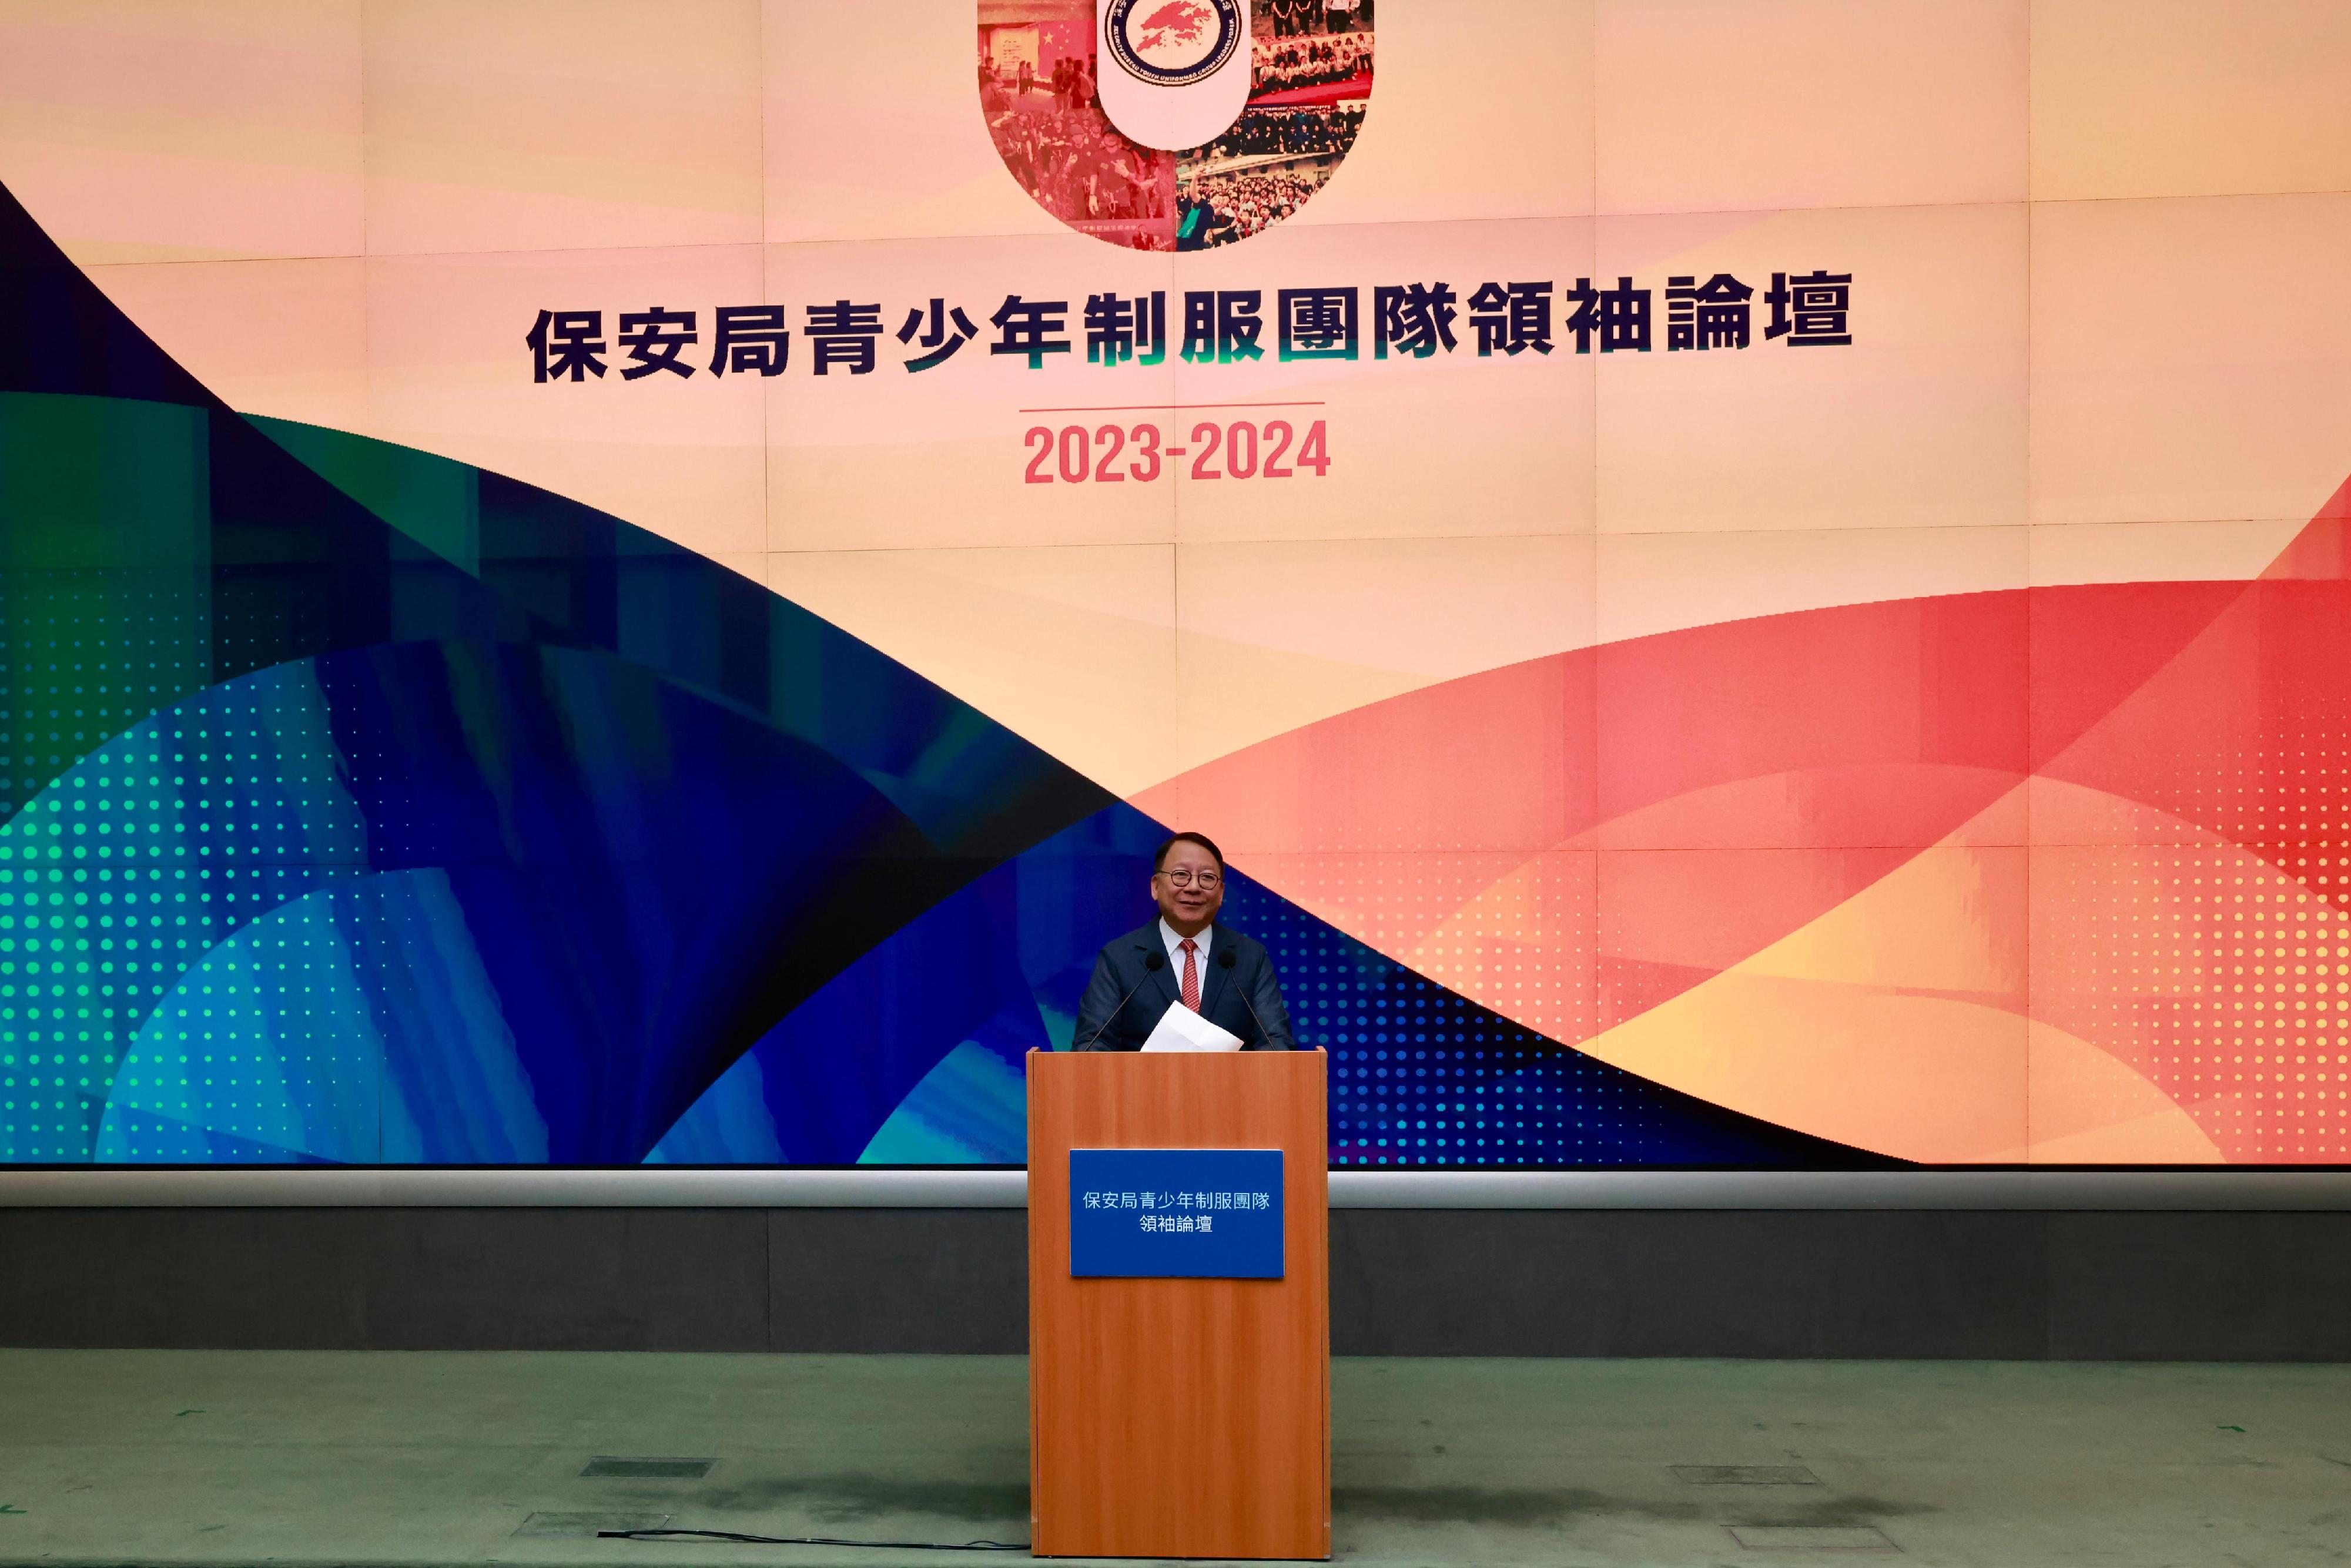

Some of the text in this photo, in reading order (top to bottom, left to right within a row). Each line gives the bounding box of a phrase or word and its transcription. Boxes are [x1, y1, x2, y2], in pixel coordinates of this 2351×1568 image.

[525, 270, 1853, 384] 保安局青少年制服團隊領袖論壇
[1024, 420, 1331, 483] 2023-2024
[1083, 1191, 1270, 1210] 保安局青少年制服團隊
[1139, 1215, 1213, 1232] 領袖論壇
